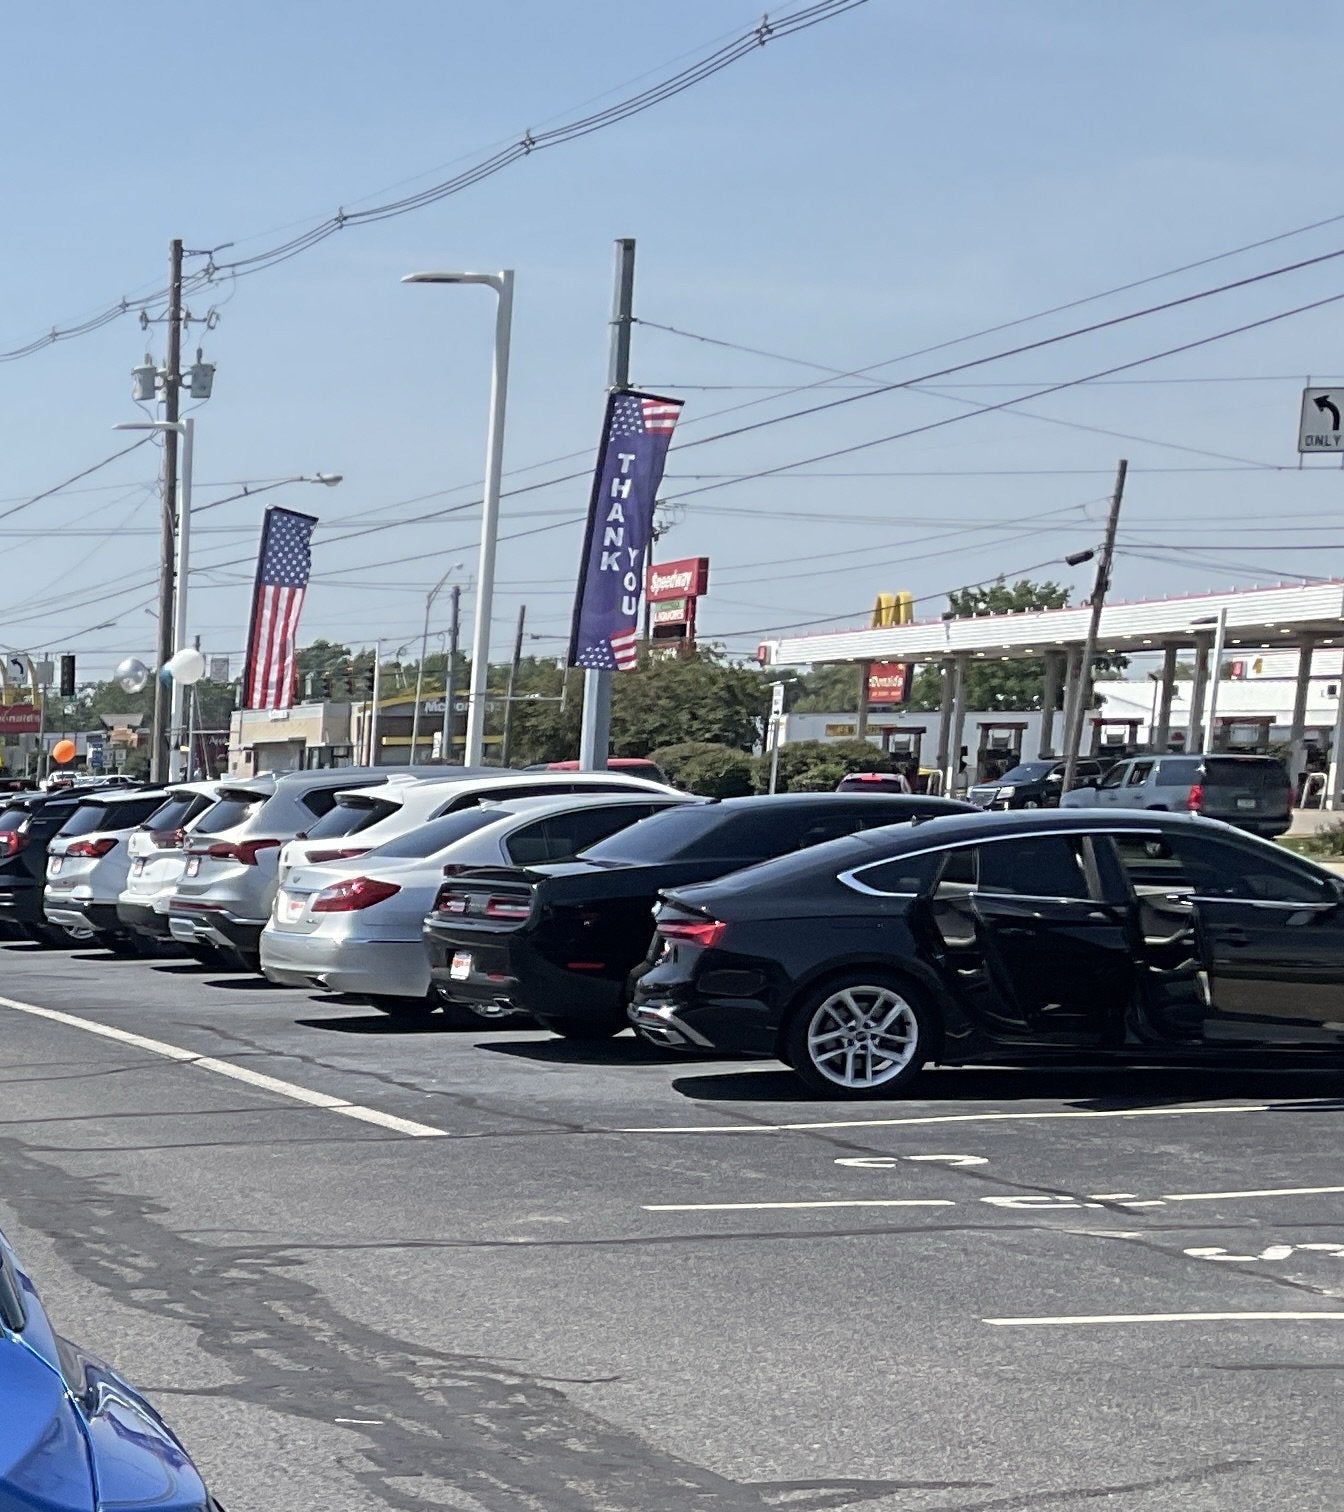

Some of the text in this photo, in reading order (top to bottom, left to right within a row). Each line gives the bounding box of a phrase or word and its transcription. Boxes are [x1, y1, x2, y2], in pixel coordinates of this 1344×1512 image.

[1305, 435, 1341, 447] ONLY
[600, 452, 636, 572] THANK
[621, 547, 640, 616] YOU
[651, 569, 693, 596] Speedway
